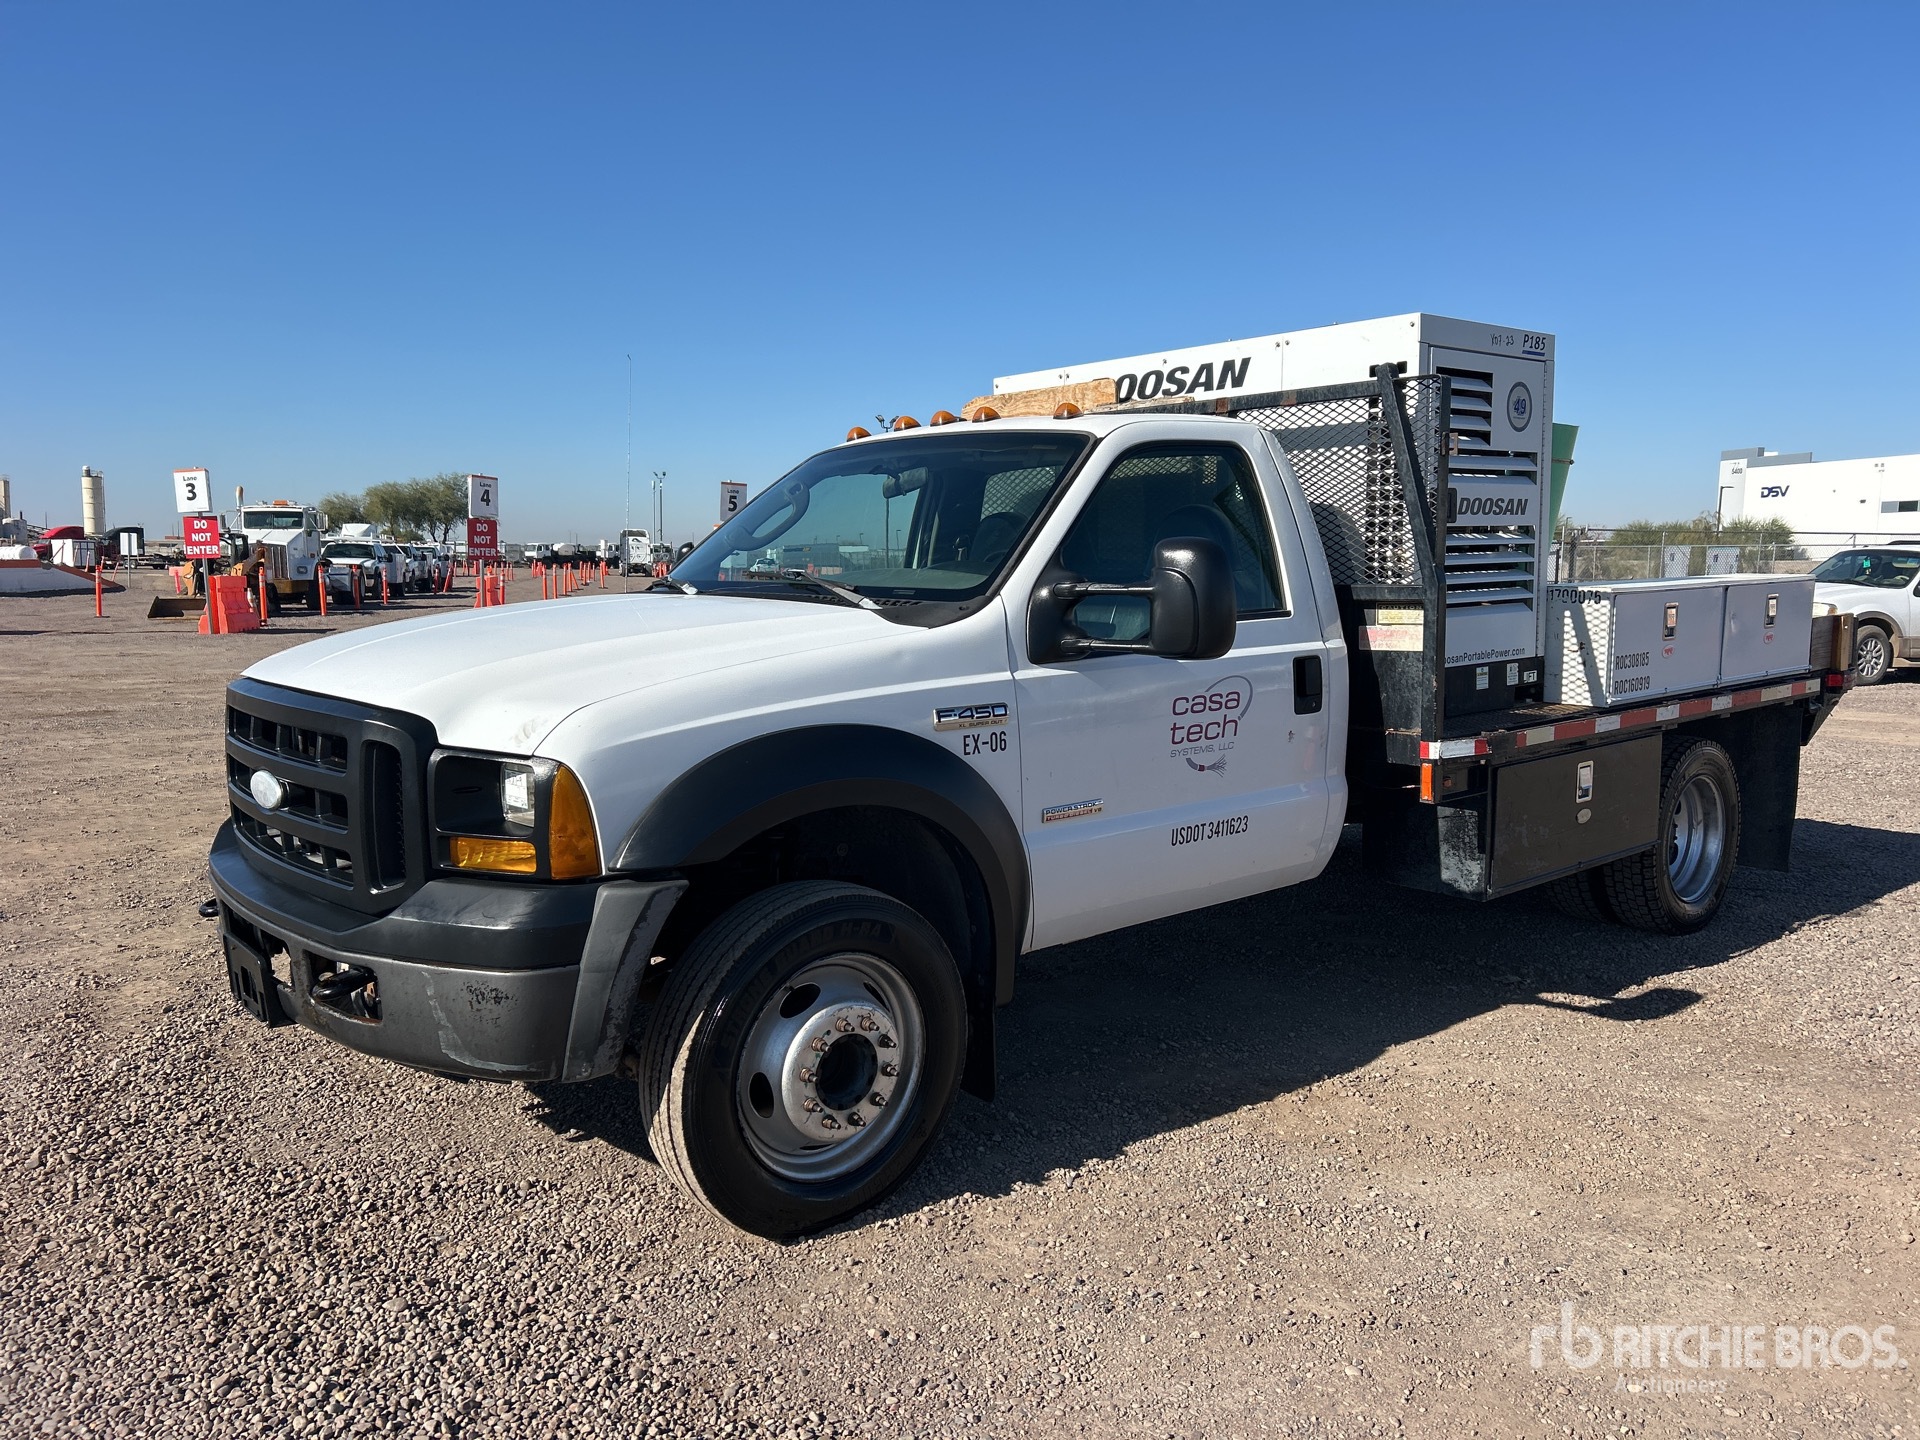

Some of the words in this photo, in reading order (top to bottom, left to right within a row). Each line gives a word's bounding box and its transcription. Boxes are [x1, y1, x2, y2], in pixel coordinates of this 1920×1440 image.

[1522, 334, 1546, 351] P185
[1116, 356, 1252, 403] OOSAN
[185, 482, 197, 501] 3
[480, 489, 491, 507] 4
[1760, 485, 1790, 498] DSV
[727, 495, 738, 512] 5
[1457, 497, 1529, 516] DOOSAN
[193, 520, 207, 529] DO
[476, 523, 489, 532] DO
[191, 532, 212, 542] NOT
[473, 535, 492, 544] NOT
[186, 545, 219, 555] ENTER
[469, 547, 497, 557] ENTER
[1615, 651, 1650, 671] ROC308185
[1613, 675, 1650, 696] ROC160919
[1172, 691, 1241, 716] casa
[1170, 714, 1239, 745] tech
[963, 730, 1007, 756] EX-06
[1170, 744, 1215, 758] SYSTEMS,
[1218, 741, 1235, 751] LLC
[1171, 822, 1207, 847] USDOT
[1207, 815, 1249, 840] 3411623
